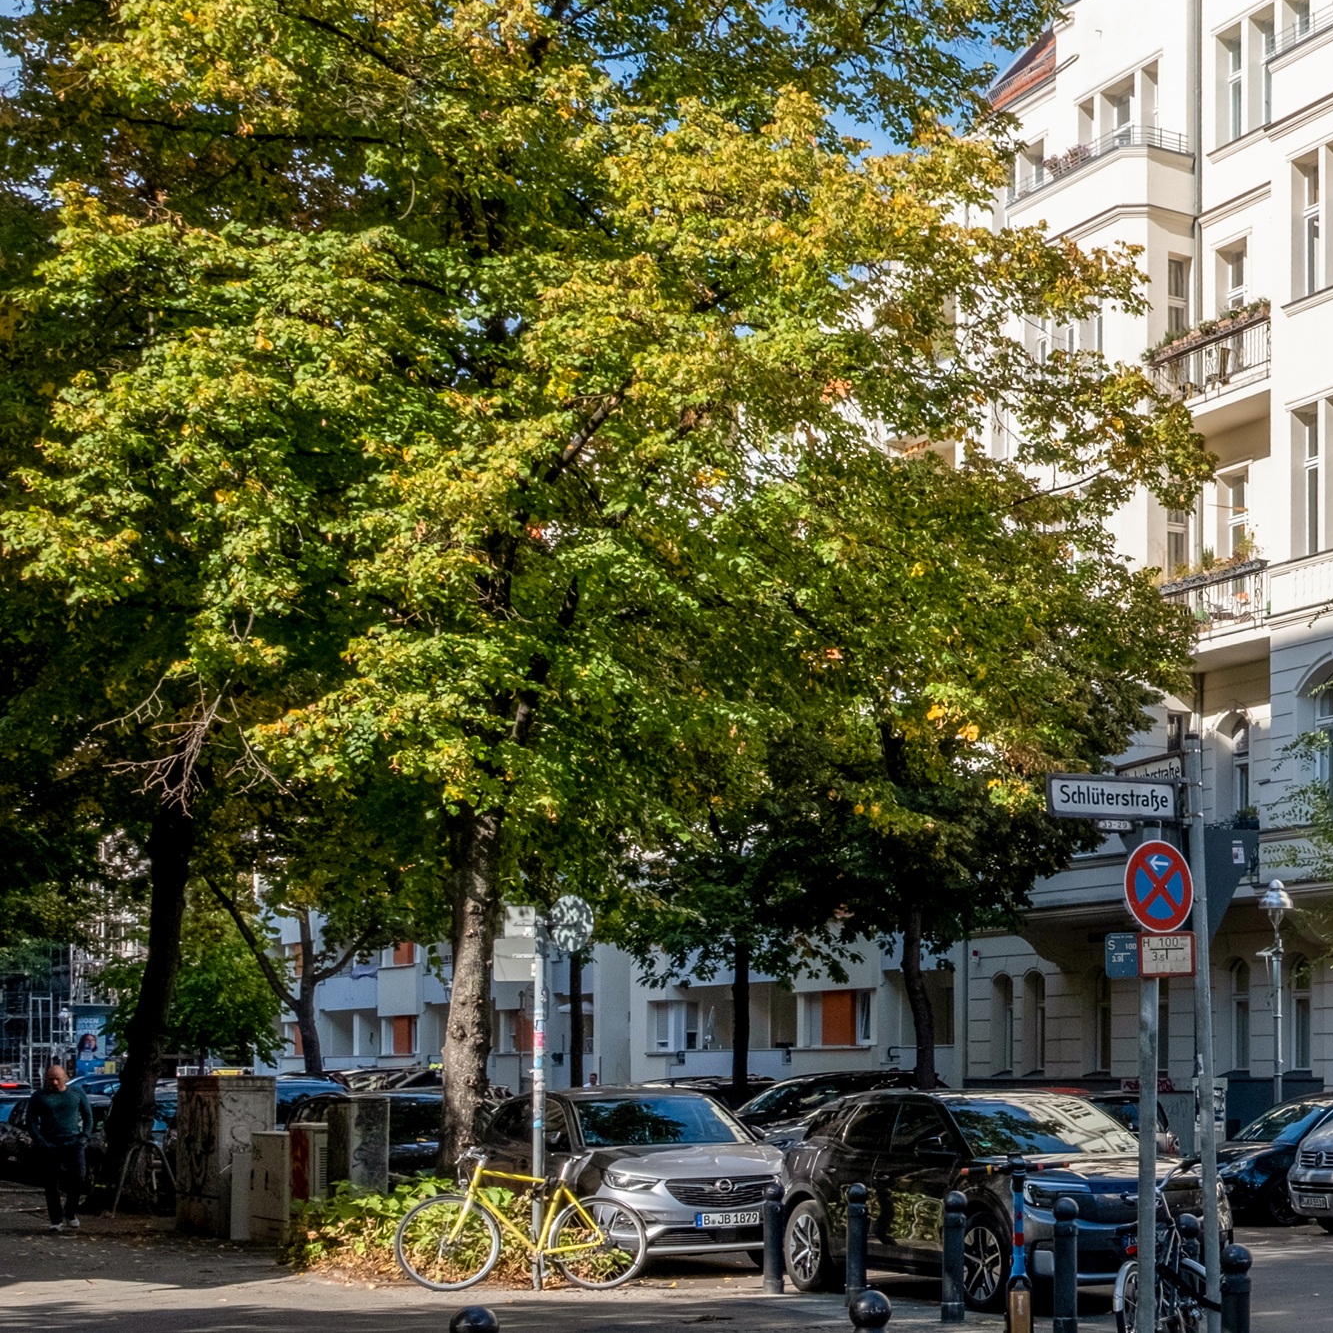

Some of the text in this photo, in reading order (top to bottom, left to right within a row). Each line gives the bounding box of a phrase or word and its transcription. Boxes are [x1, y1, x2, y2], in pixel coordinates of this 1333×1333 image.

[1060, 784, 1168, 812] Schlüterstraße
[1107, 940, 1116, 951] S
[1143, 937, 1179, 948] H 100
[703, 1213, 758, 1225] B JB 1879
